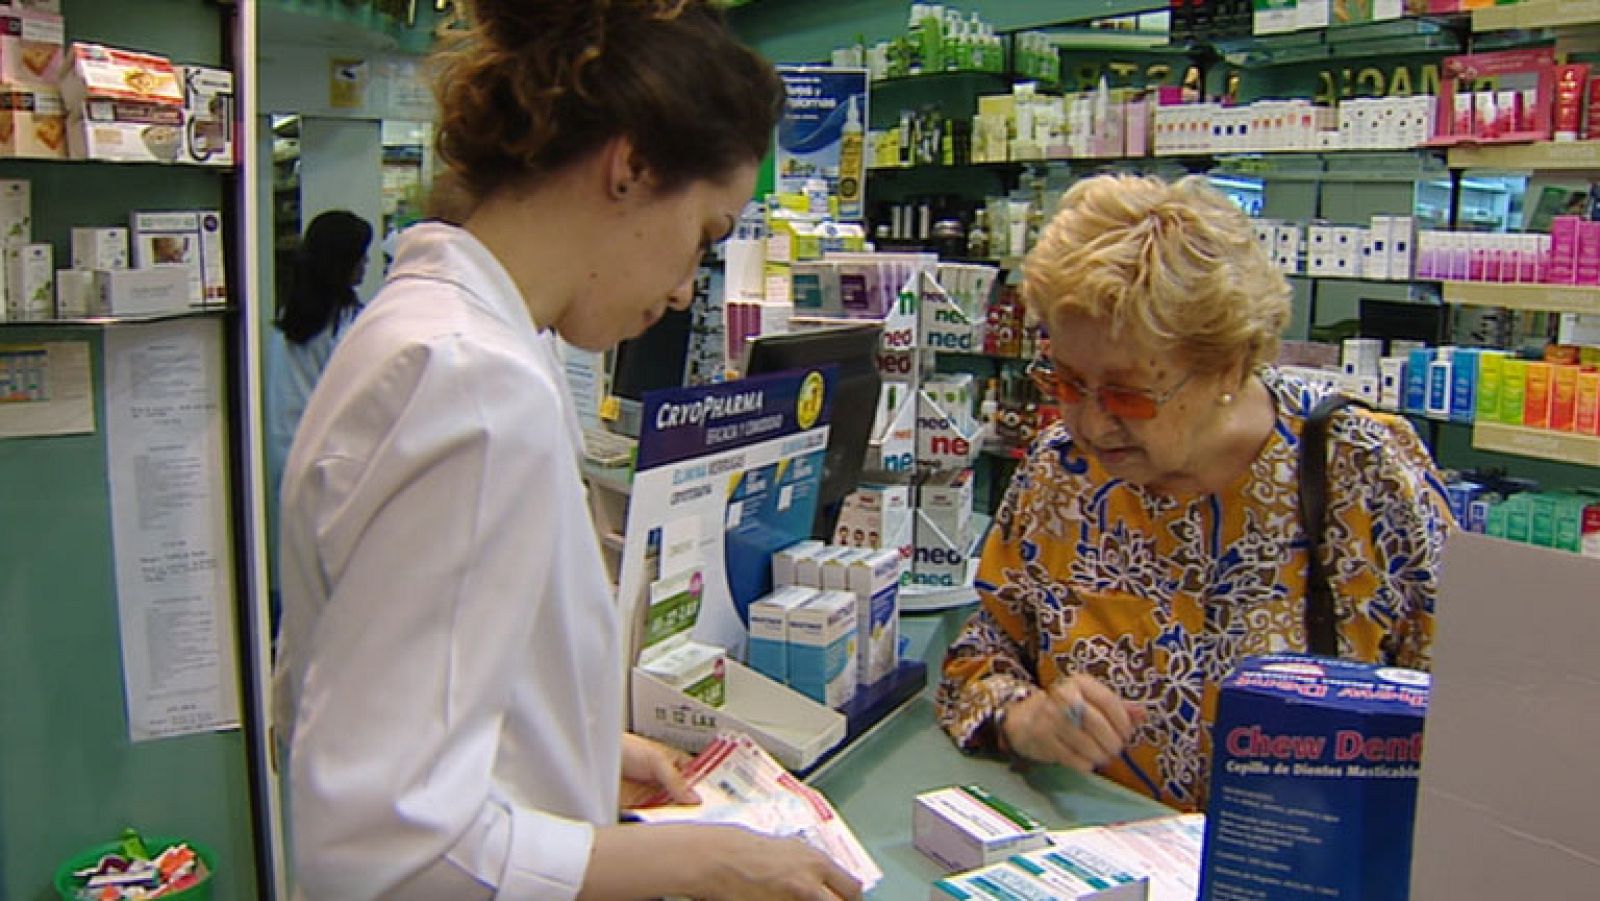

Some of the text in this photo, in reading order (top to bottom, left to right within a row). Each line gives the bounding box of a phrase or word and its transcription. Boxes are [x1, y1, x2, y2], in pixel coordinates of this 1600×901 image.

[1226, 725, 1325, 759] Chew
[1226, 760, 1270, 777] Cepillo
[1273, 763, 1289, 776] de
[1294, 763, 1342, 778] Dientes
